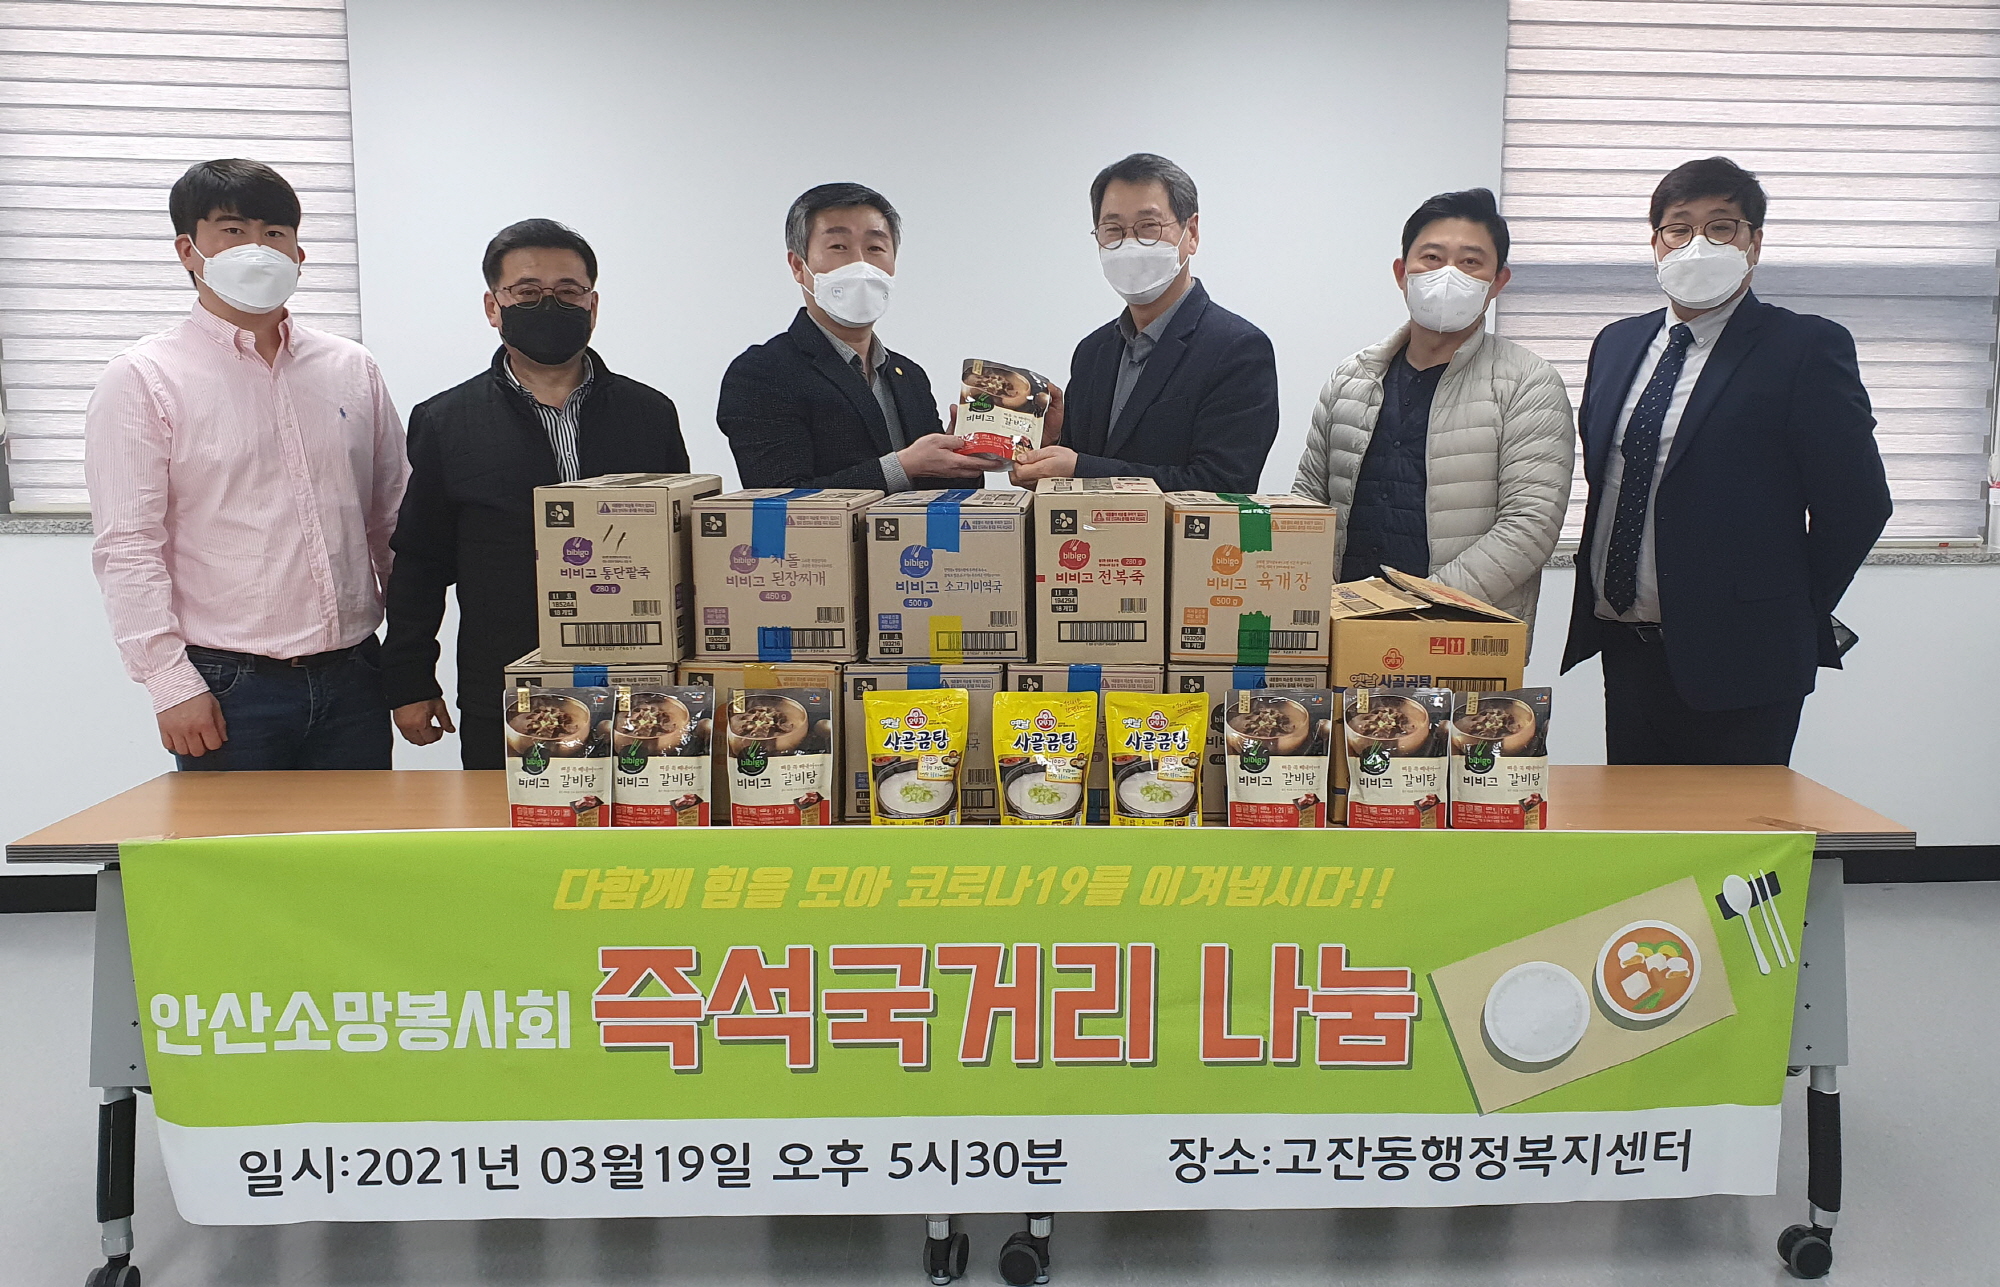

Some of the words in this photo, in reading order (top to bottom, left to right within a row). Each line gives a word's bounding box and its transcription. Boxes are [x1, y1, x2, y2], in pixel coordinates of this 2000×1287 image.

[966, 413, 995, 422] 비비고
[566, 549, 590, 558] bibigo
[1063, 552, 1086, 561] bibigo
[733, 556, 756, 566] bibigo
[904, 559, 929, 568] bibigo
[1216, 557, 1239, 567] bibigo
[560, 568, 597, 579] 비비고
[600, 566, 651, 580] 통단팥죽
[726, 575, 766, 587] 비비고
[771, 570, 826, 587] 된장찌개
[1056, 572, 1093, 584] 비비고
[1098, 569, 1145, 585] 전복죽
[595, 585, 609, 593] 280
[896, 580, 939, 594] 비비고
[944, 580, 1003, 594] 소고기미역국
[1206, 577, 1247, 590] 비비고
[1257, 572, 1311, 592] 육개장
[908, 599, 922, 607] 500
[1350, 673, 1379, 688] 옛날
[1379, 674, 1432, 688] 사골곰탕
[880, 717, 901, 729] 옛날
[908, 717, 924, 725] 오뚜기
[1010, 718, 1031, 730] 옛날
[1038, 718, 1054, 726] 오뚜기
[1122, 717, 1143, 729] 옛날
[883, 728, 950, 752] 사골곰탕
[1011, 731, 1078, 753] 사골곰탕
[1125, 730, 1189, 752] 사골곰탕
[621, 757, 644, 766] bibigo
[741, 758, 765, 767] bibigo
[1243, 756, 1266, 765] bibigo
[1468, 756, 1491, 766] bibigo
[518, 777, 550, 788] 비비고
[560, 774, 596, 788] 갈비탕
[617, 776, 649, 788] 비비고
[659, 772, 696, 787] 갈비탕
[737, 777, 772, 789] 비비고
[781, 770, 818, 786] 갈비탕
[1238, 776, 1272, 786] 비비고
[1282, 772, 1316, 786] 갈비탕
[1359, 777, 1393, 788] 비비고
[1402, 774, 1437, 787] 갈비탕
[1463, 776, 1498, 787] 비비고
[1507, 773, 1541, 786] 갈비탕
[552, 865, 695, 910] 다함께
[701, 864, 794, 909] 힘을
[798, 865, 893, 908] 모아
[898, 864, 1134, 908] 코로나19를
[1138, 864, 1396, 909] 이겨냅시다!!
[591, 941, 1159, 1073] 즉석국거리
[1199, 942, 1421, 1068] 나눔
[149, 988, 571, 1057] 안산소망봉사회
[239, 1143, 520, 1197] 일시:2021년
[772, 1138, 869, 1188] 오후
[887, 1138, 1068, 1186] 5시30분
[1167, 1128, 1693, 1184] 장소:고잔동행정복지센터
